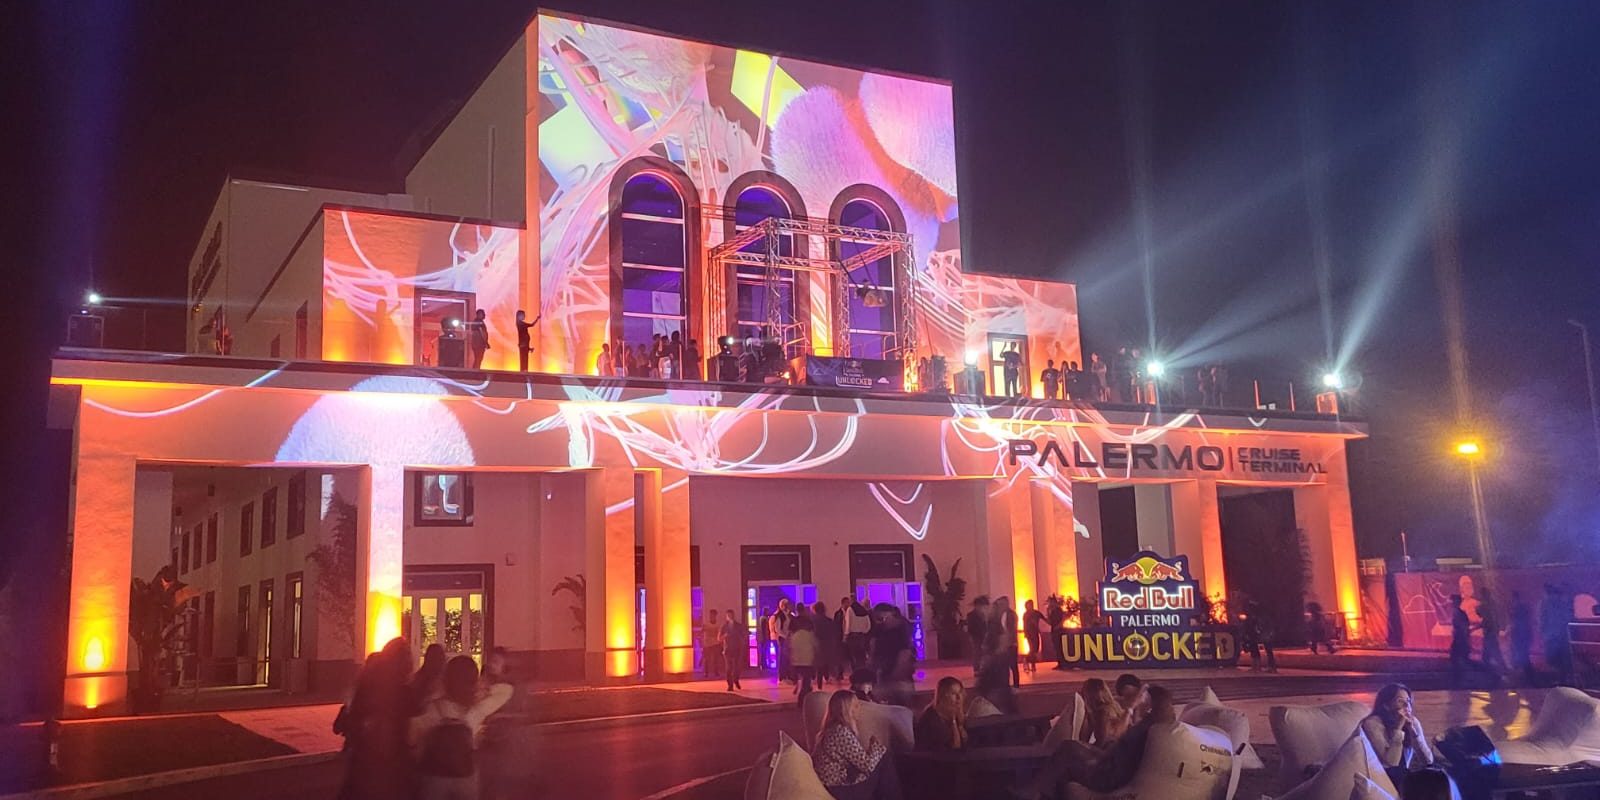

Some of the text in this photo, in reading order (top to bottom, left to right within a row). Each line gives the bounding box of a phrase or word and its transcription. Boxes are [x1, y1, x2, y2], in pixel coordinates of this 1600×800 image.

[837, 377, 872, 385] UNLOCKED
[1008, 439, 1225, 472] PALERMO
[1237, 447, 1301, 461] CRUISE
[1238, 460, 1329, 474] TERMINAL
[1103, 585, 1195, 611] Red Bull
[1120, 614, 1180, 627] PALERMO
[1061, 631, 1236, 662] UNLOCKED
